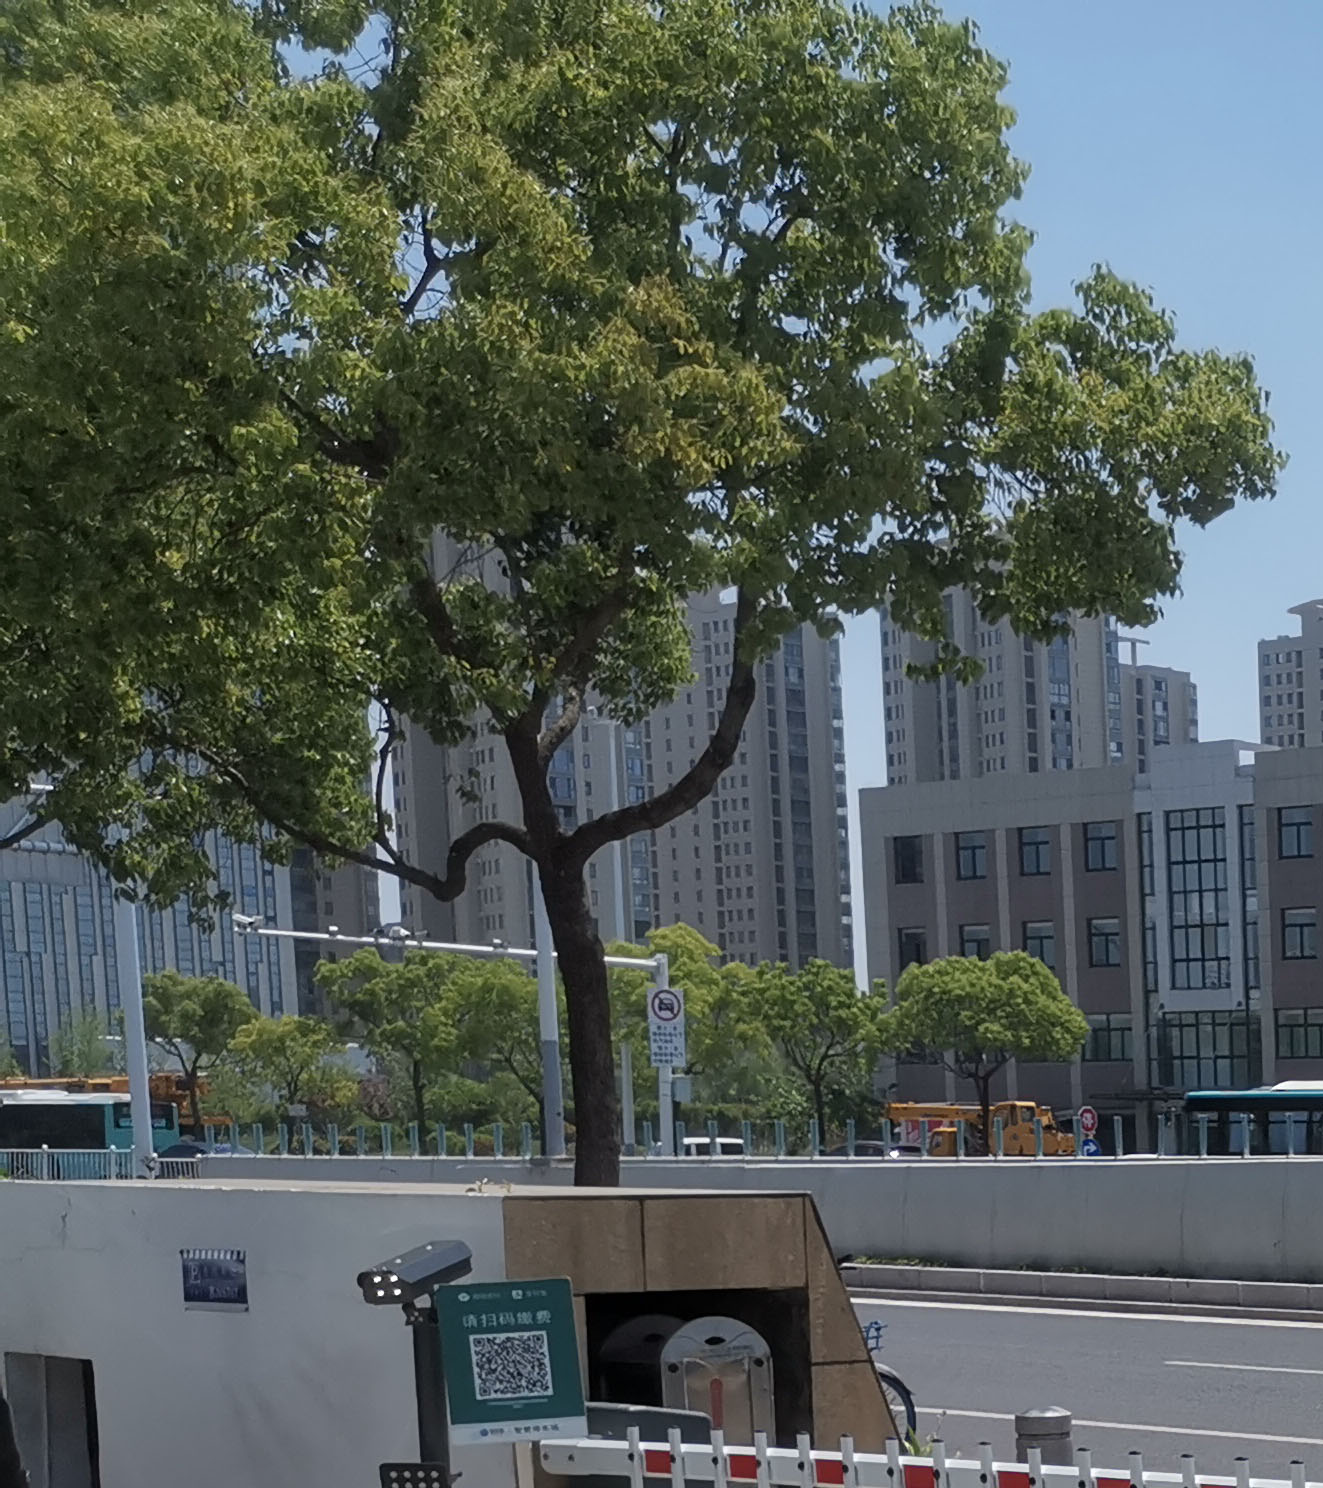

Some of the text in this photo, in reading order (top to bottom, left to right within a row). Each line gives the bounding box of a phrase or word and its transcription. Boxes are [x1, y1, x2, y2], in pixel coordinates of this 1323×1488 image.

[462, 1310, 552, 1328] 请扫码缴费
